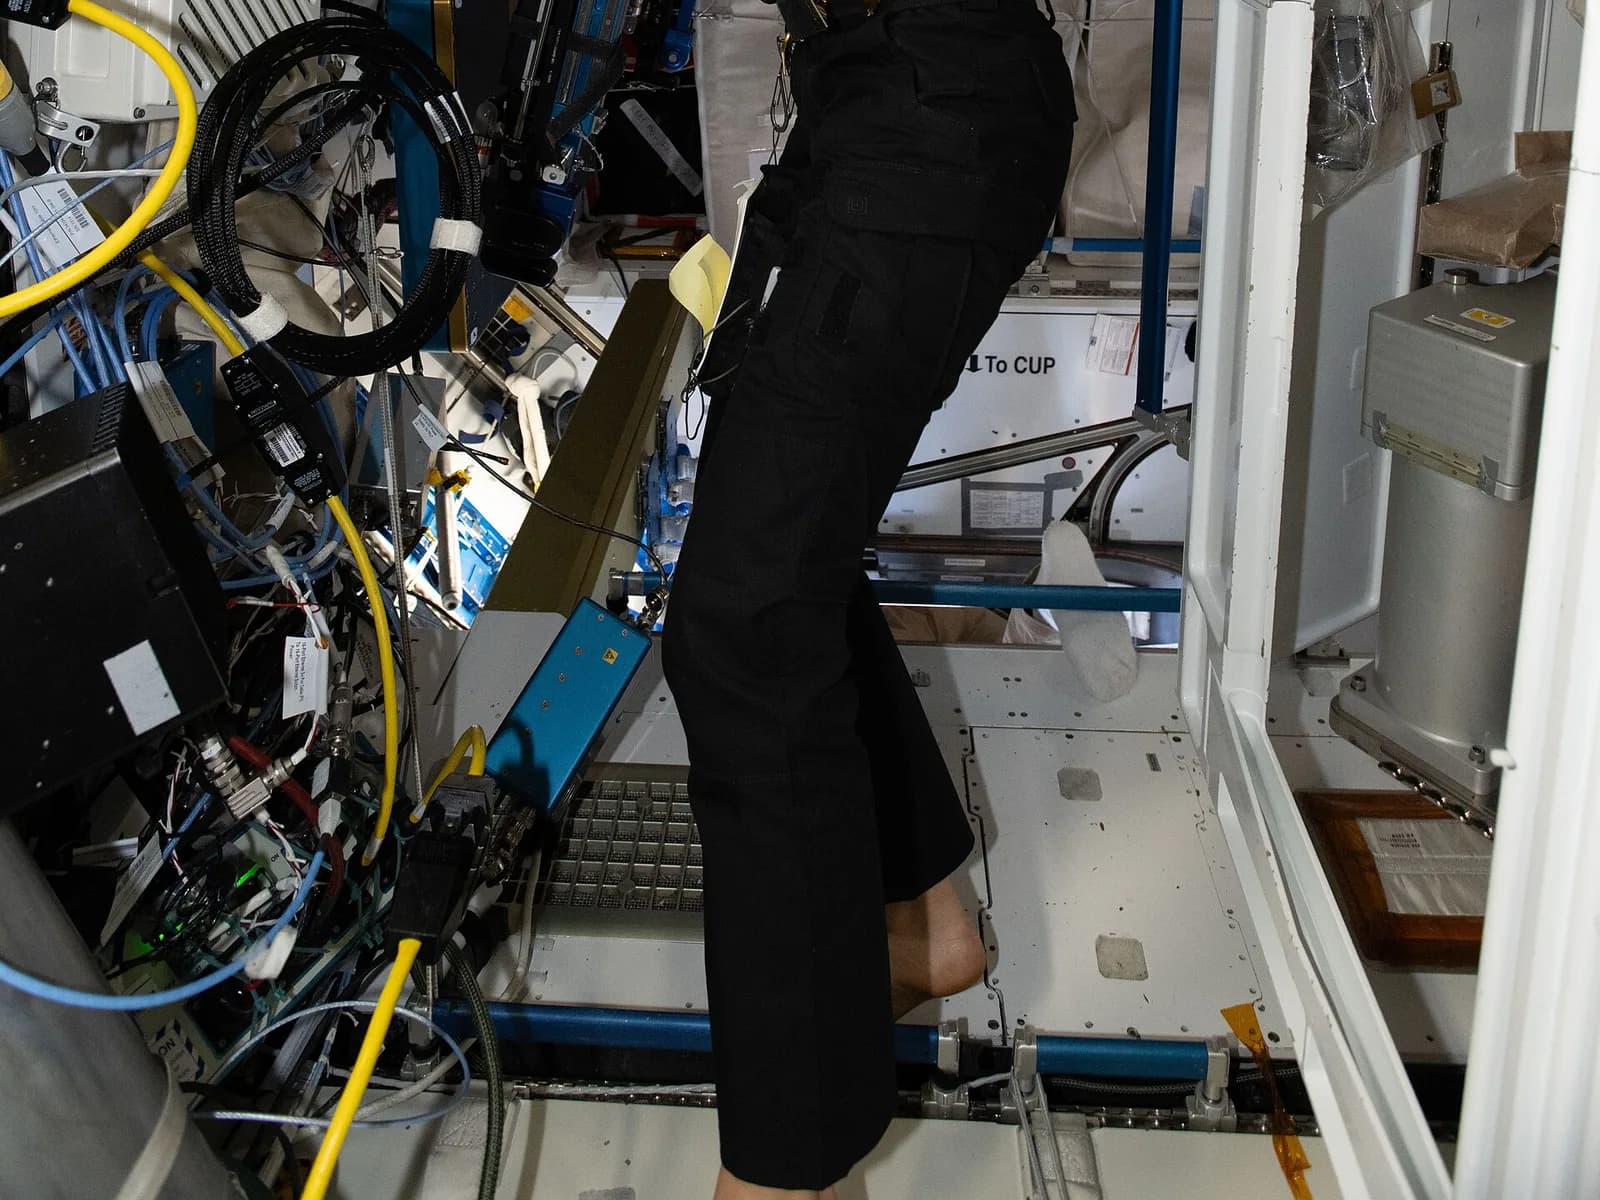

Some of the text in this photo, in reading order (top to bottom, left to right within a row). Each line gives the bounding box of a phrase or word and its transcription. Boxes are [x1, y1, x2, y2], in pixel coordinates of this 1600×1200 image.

[985, 355, 1055, 374] To CUP
[271, 853, 279, 862] ON
[159, 1039, 175, 1056] ON
